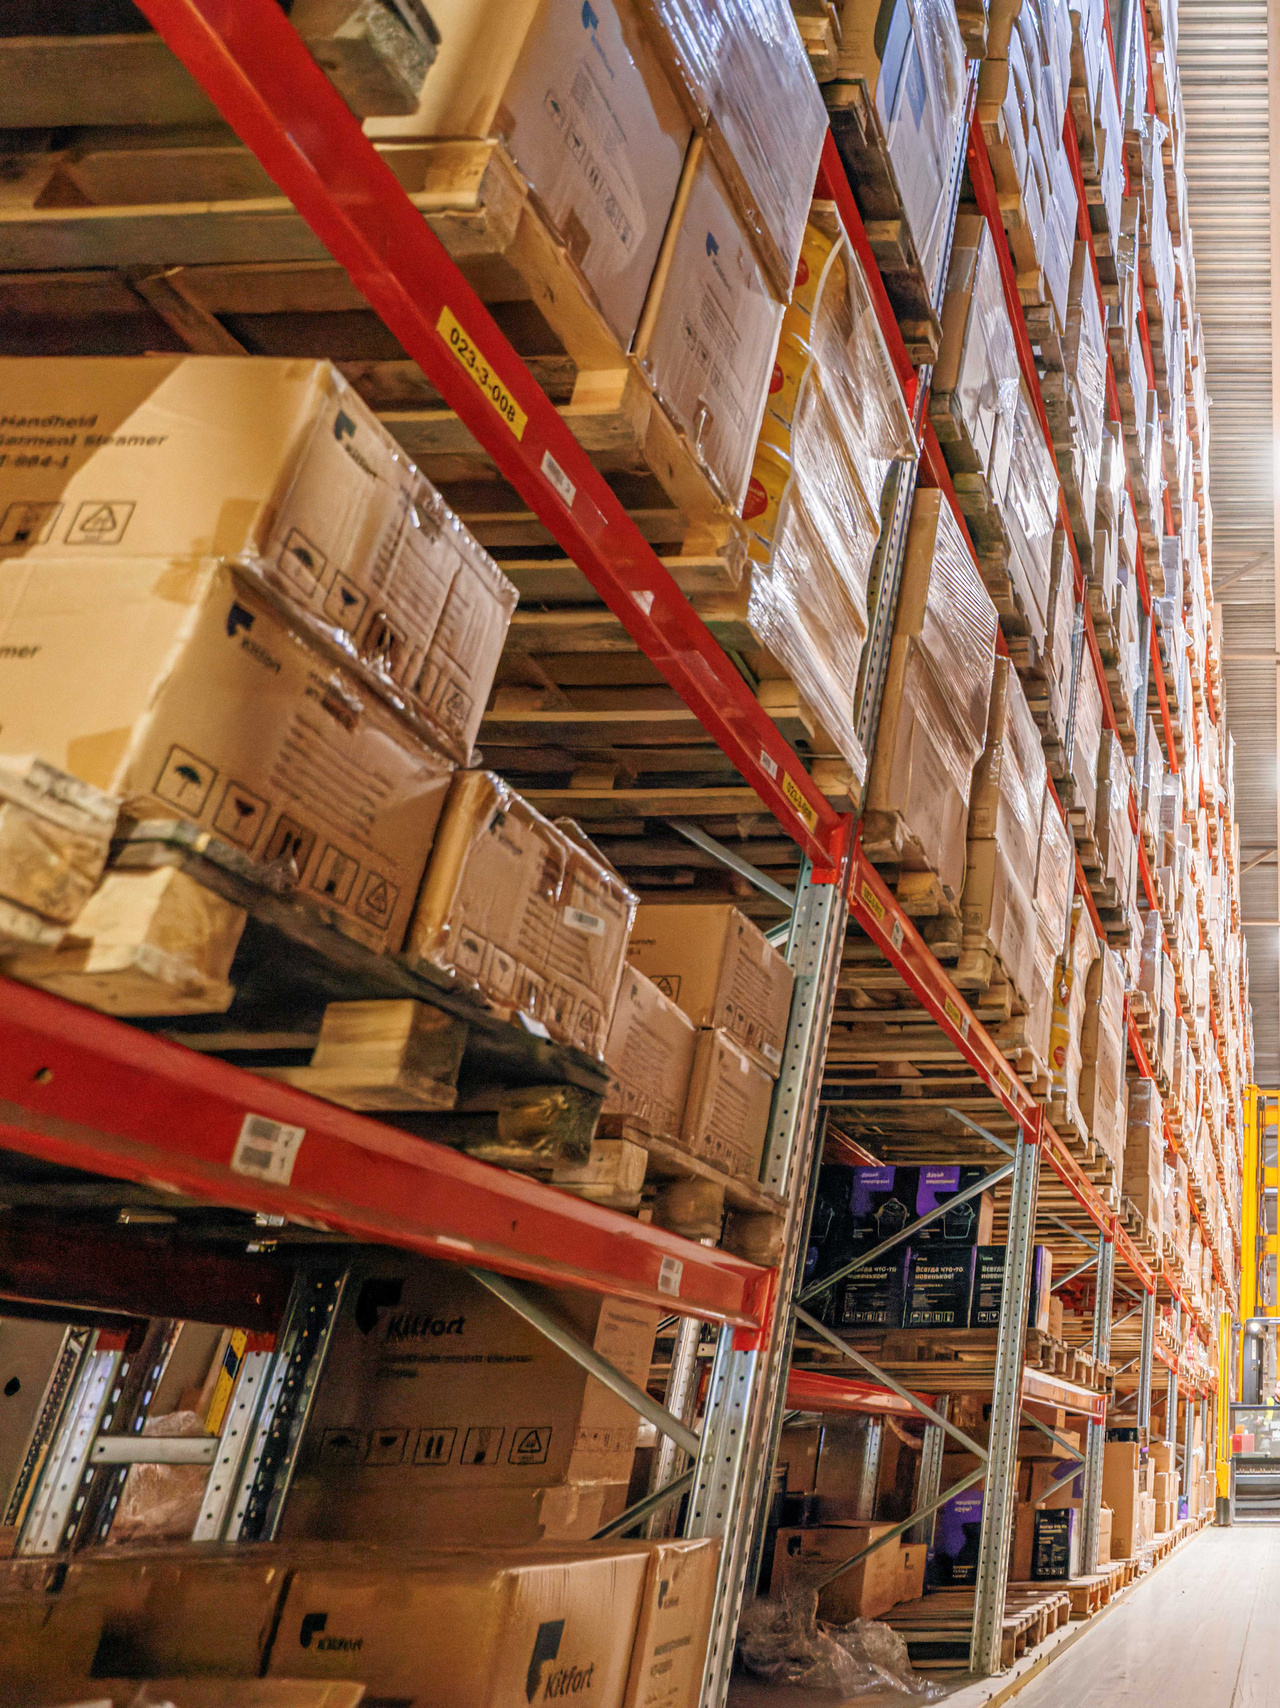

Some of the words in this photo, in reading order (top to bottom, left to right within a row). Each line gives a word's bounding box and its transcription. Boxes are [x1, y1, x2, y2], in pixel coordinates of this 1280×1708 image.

[450, 327, 516, 423] 023-3-008
[1, 414, 98, 428] Handheld
[84, 434, 168, 446] Steamer
[543, 1662, 595, 1702] Kitfort
